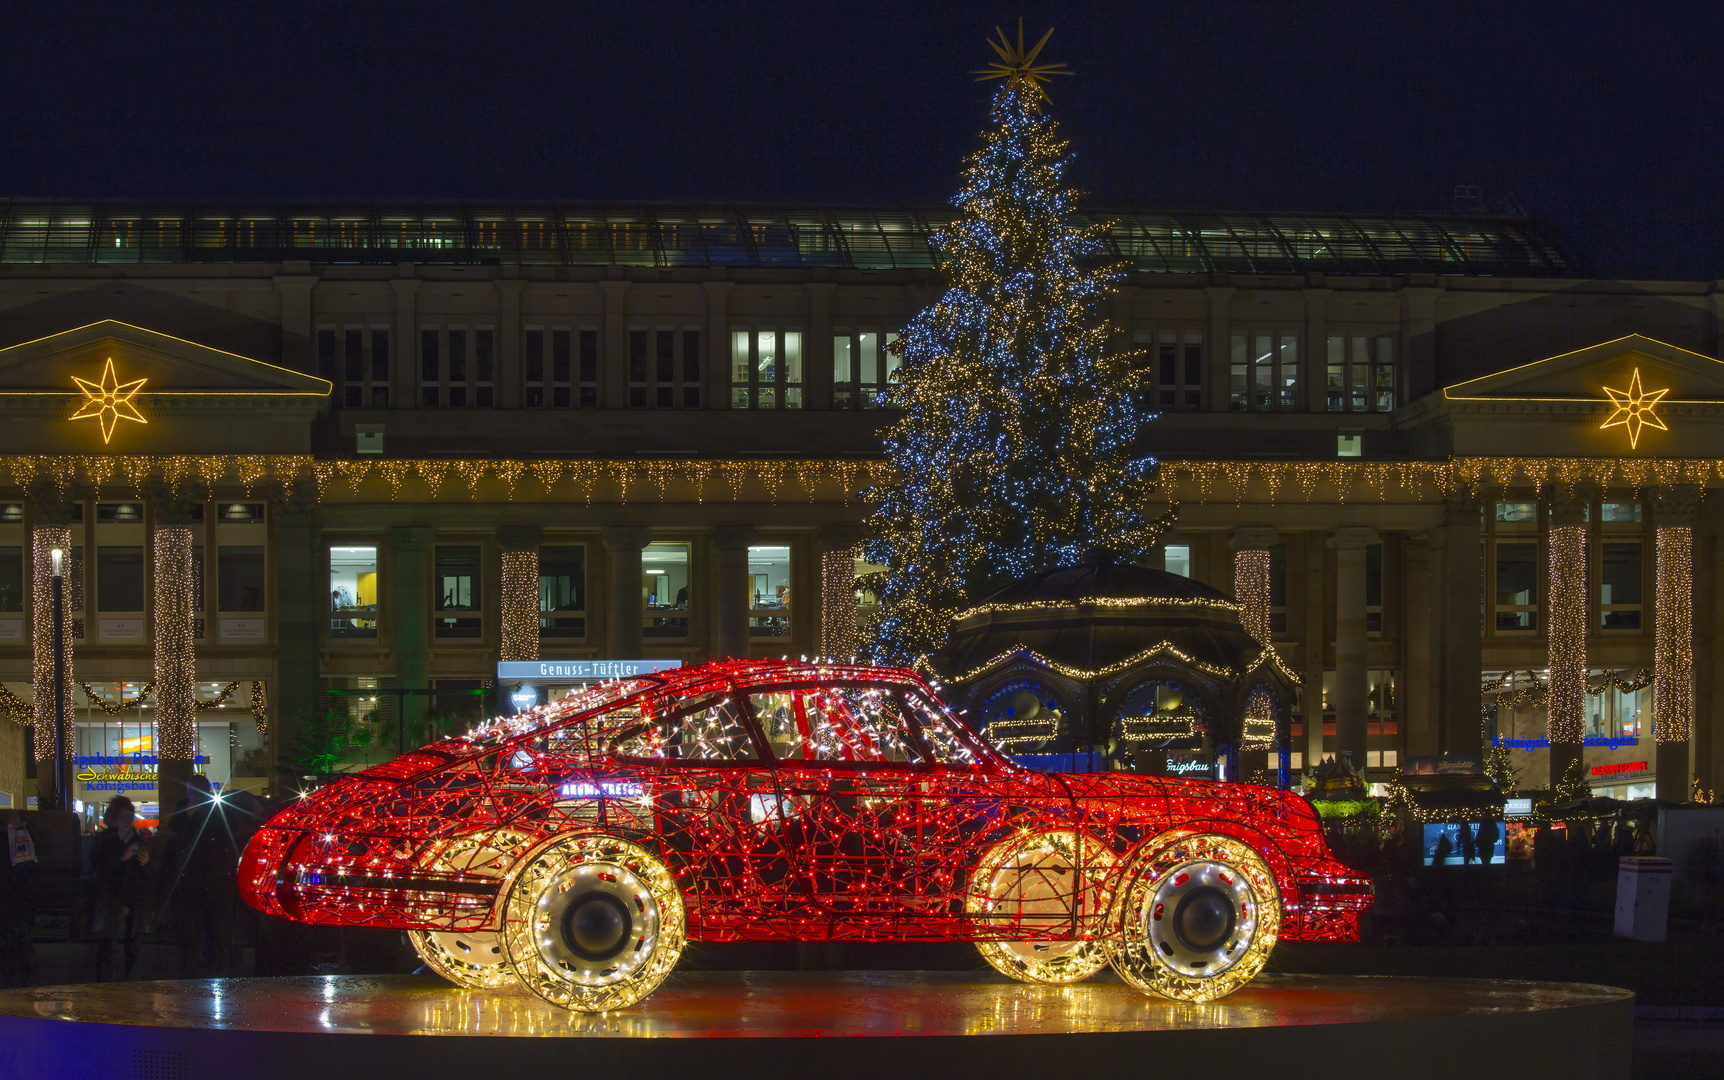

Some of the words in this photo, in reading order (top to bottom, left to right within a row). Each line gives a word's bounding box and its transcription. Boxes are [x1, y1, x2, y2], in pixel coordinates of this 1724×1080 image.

[540, 662, 639, 676] Genuss-Tüftler
[1583, 735, 1635, 750] assagen
[86, 781, 154, 794] Königsbau
